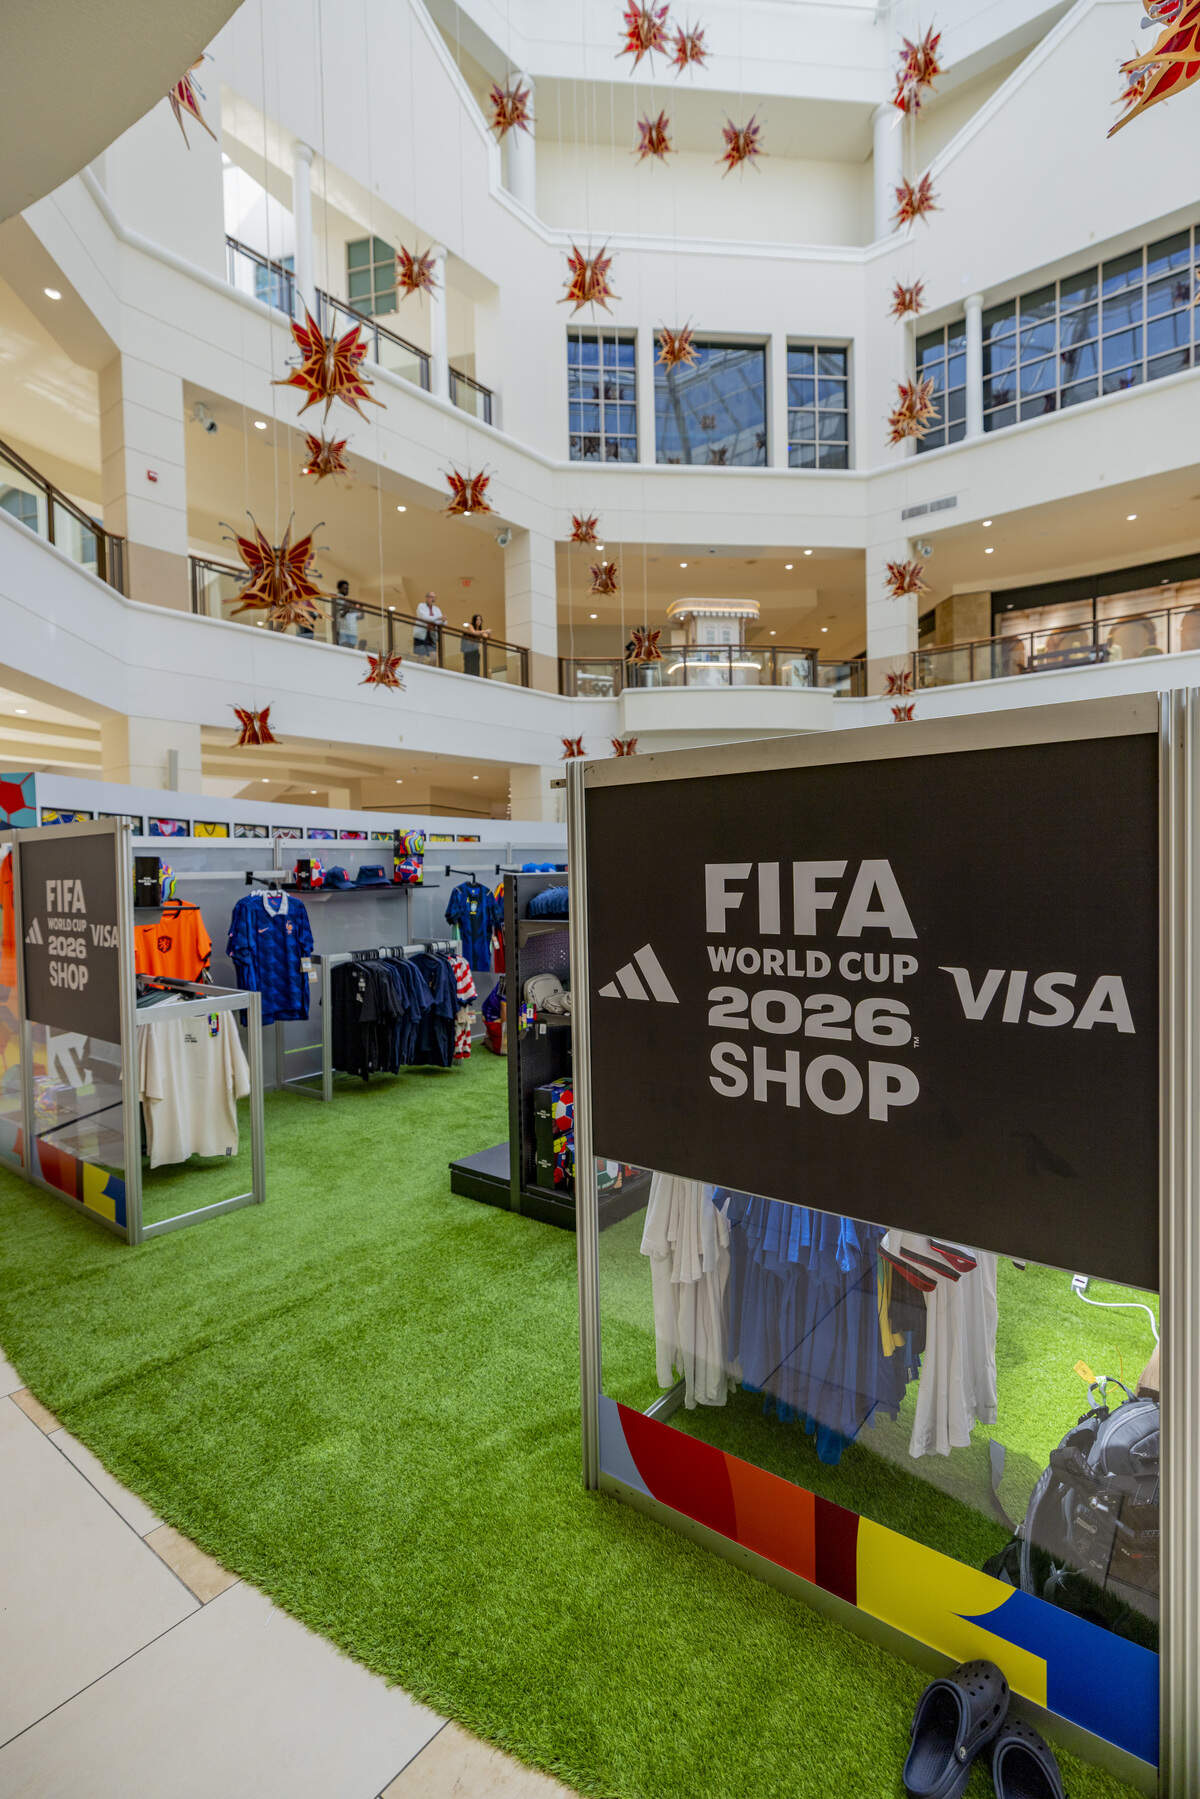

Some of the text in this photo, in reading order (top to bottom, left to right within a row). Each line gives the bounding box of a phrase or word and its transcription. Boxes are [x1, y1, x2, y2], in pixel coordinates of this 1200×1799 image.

[46, 879, 87, 914] FIFA
[705, 859, 919, 940] FIFA
[48, 918, 87, 932] WORLD CUP
[90, 924, 118, 948] VISA
[48, 936, 87, 959] 2026
[707, 946, 919, 984] WORLD CUP
[49, 961, 89, 991] SHOP
[708, 986, 912, 1047] 2026
[938, 966, 1137, 1034] VISA
[709, 1042, 920, 1123] SHOP
